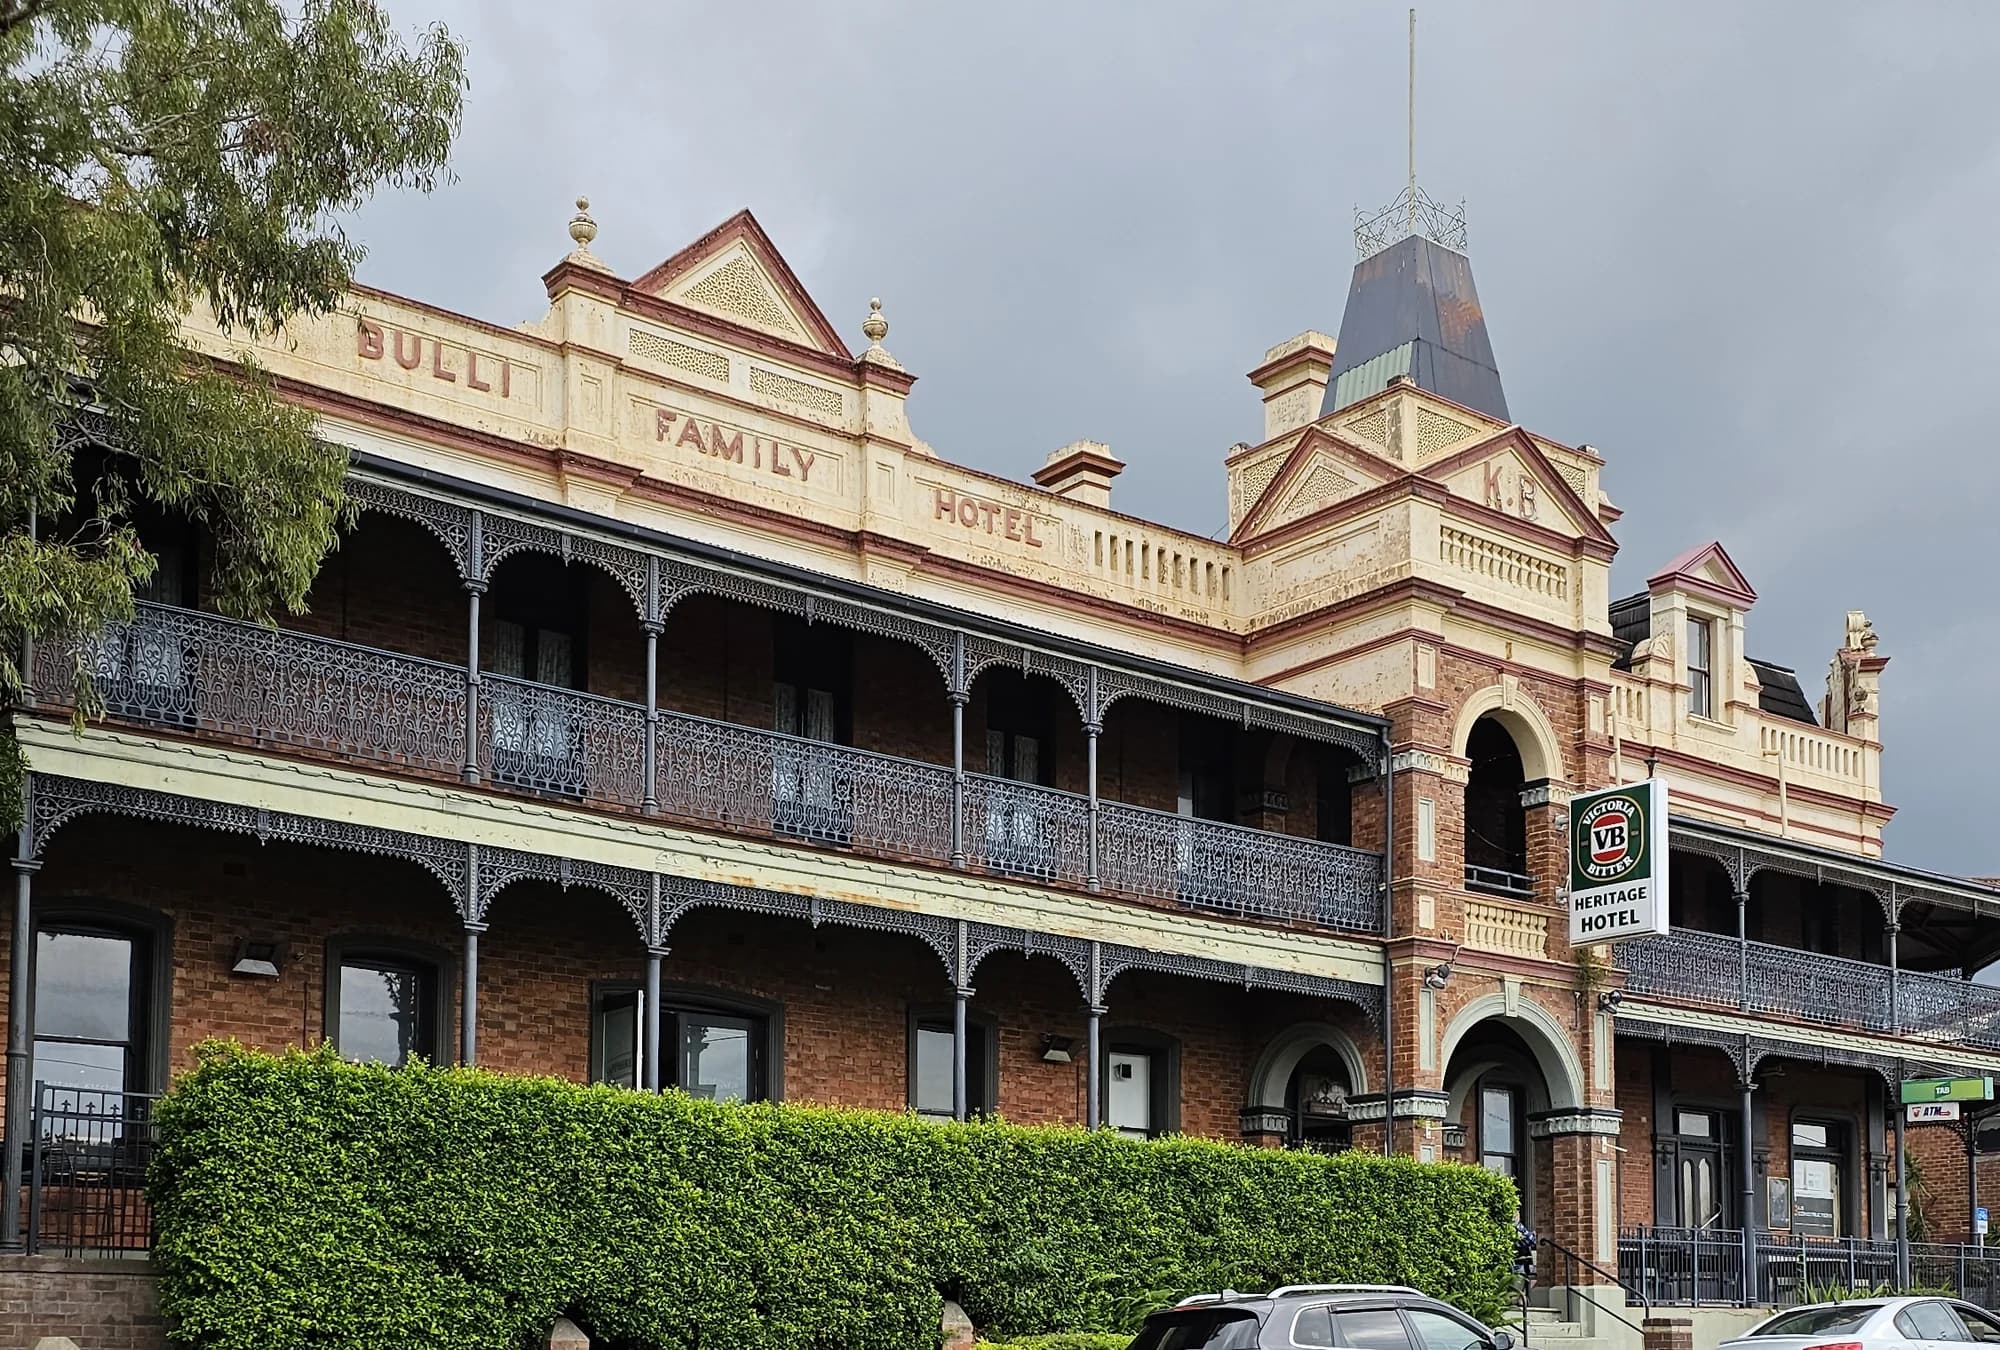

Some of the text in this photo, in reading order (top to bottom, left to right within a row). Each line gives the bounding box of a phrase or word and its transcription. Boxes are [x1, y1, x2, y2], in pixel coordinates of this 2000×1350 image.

[358, 320, 511, 398] BULLI
[656, 407, 815, 481] FAMILY
[934, 487, 1042, 547] HOTEL
[1582, 800, 1635, 826] VICTORIA
[1593, 826, 1625, 850] VB
[1586, 856, 1634, 877] BITTER
[1575, 886, 1647, 911] HERITAGE
[1581, 909, 1640, 933] HOTEL
[1935, 1086, 1950, 1094] TAB
[1923, 1106, 1942, 1116] ATM
